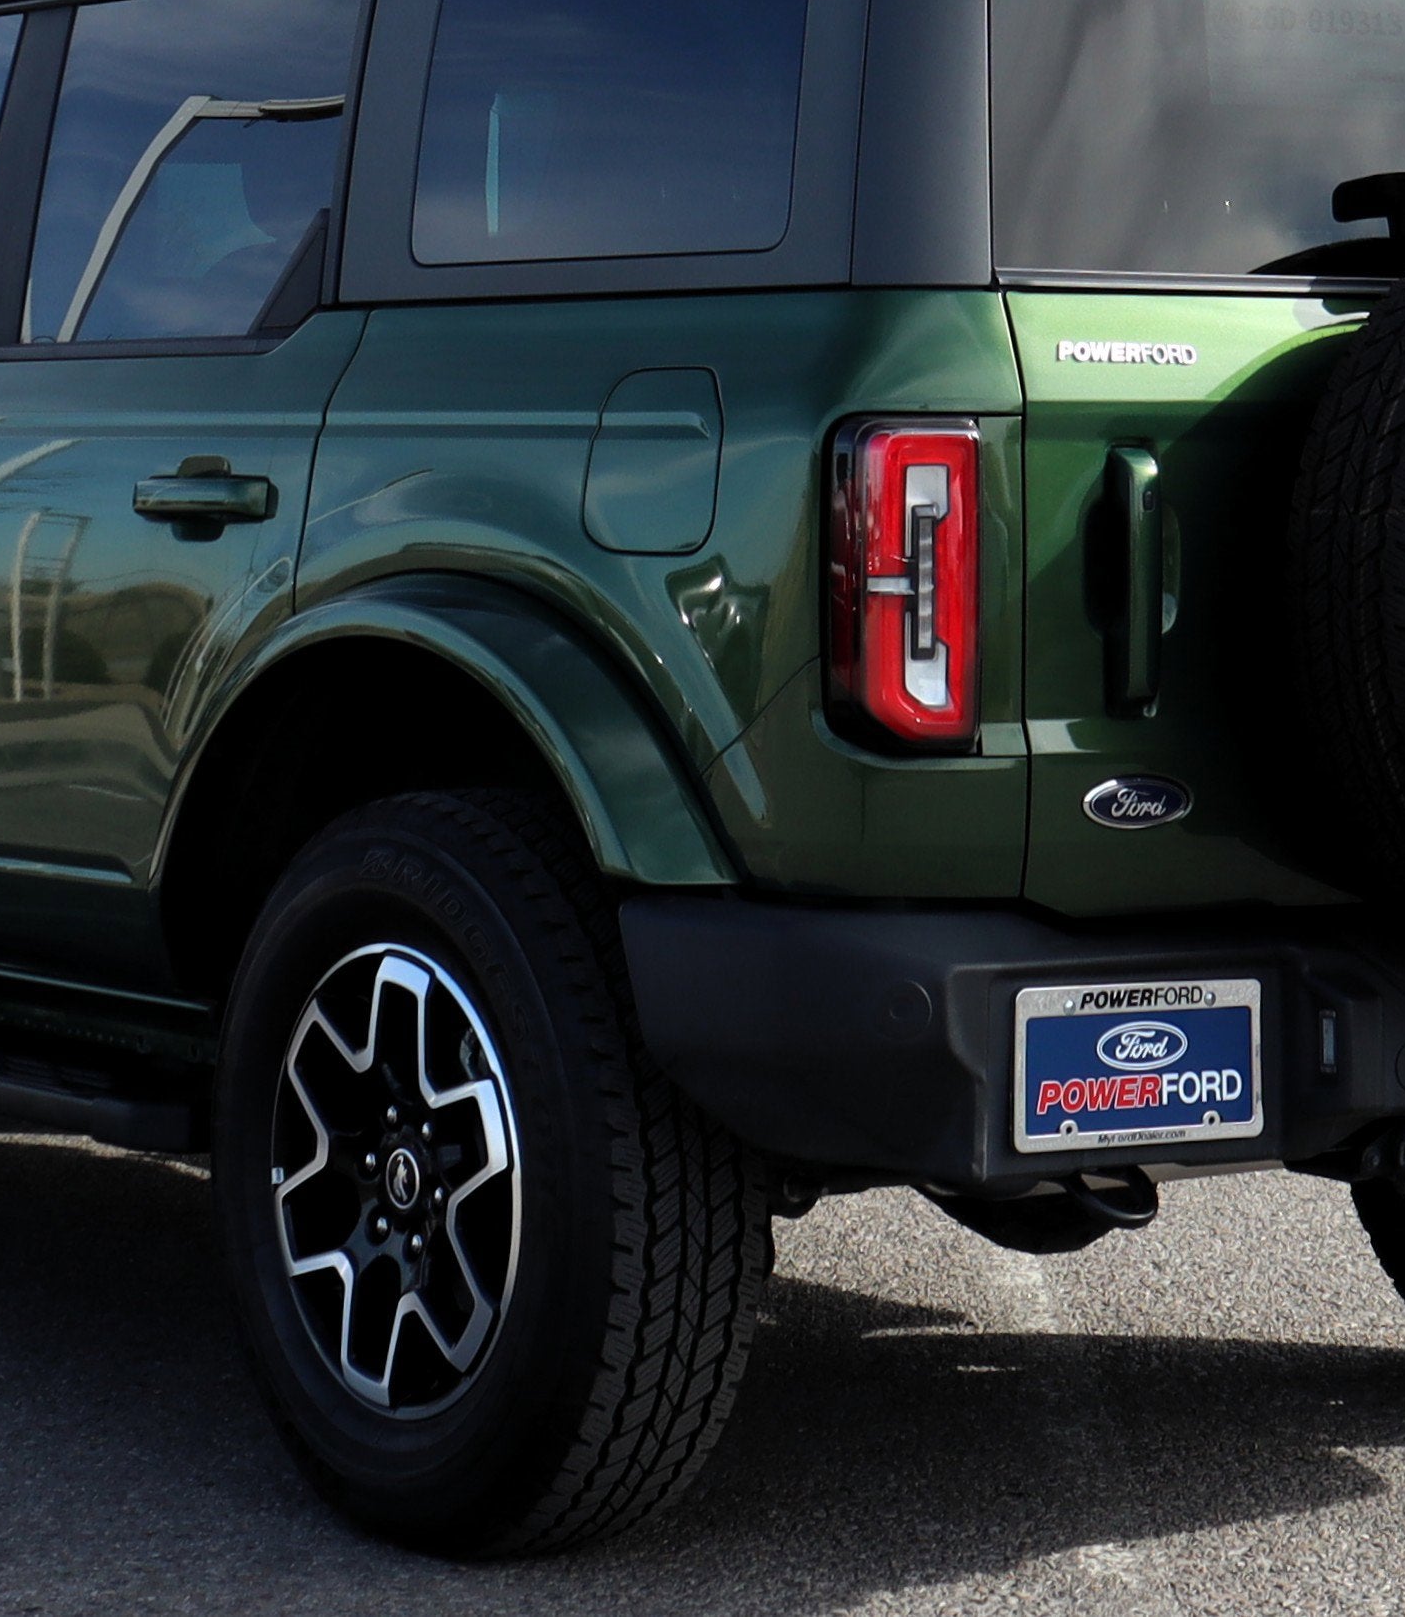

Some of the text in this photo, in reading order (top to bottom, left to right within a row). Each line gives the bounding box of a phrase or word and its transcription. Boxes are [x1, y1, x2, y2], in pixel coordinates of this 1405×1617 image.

[1056, 340, 1197, 365] POWERFORD
[1110, 787, 1167, 817] Ford
[1079, 986, 1203, 1010] POWERFORD
[1114, 1029, 1169, 1060] Ford
[1036, 1068, 1243, 1115] POWERFORD
